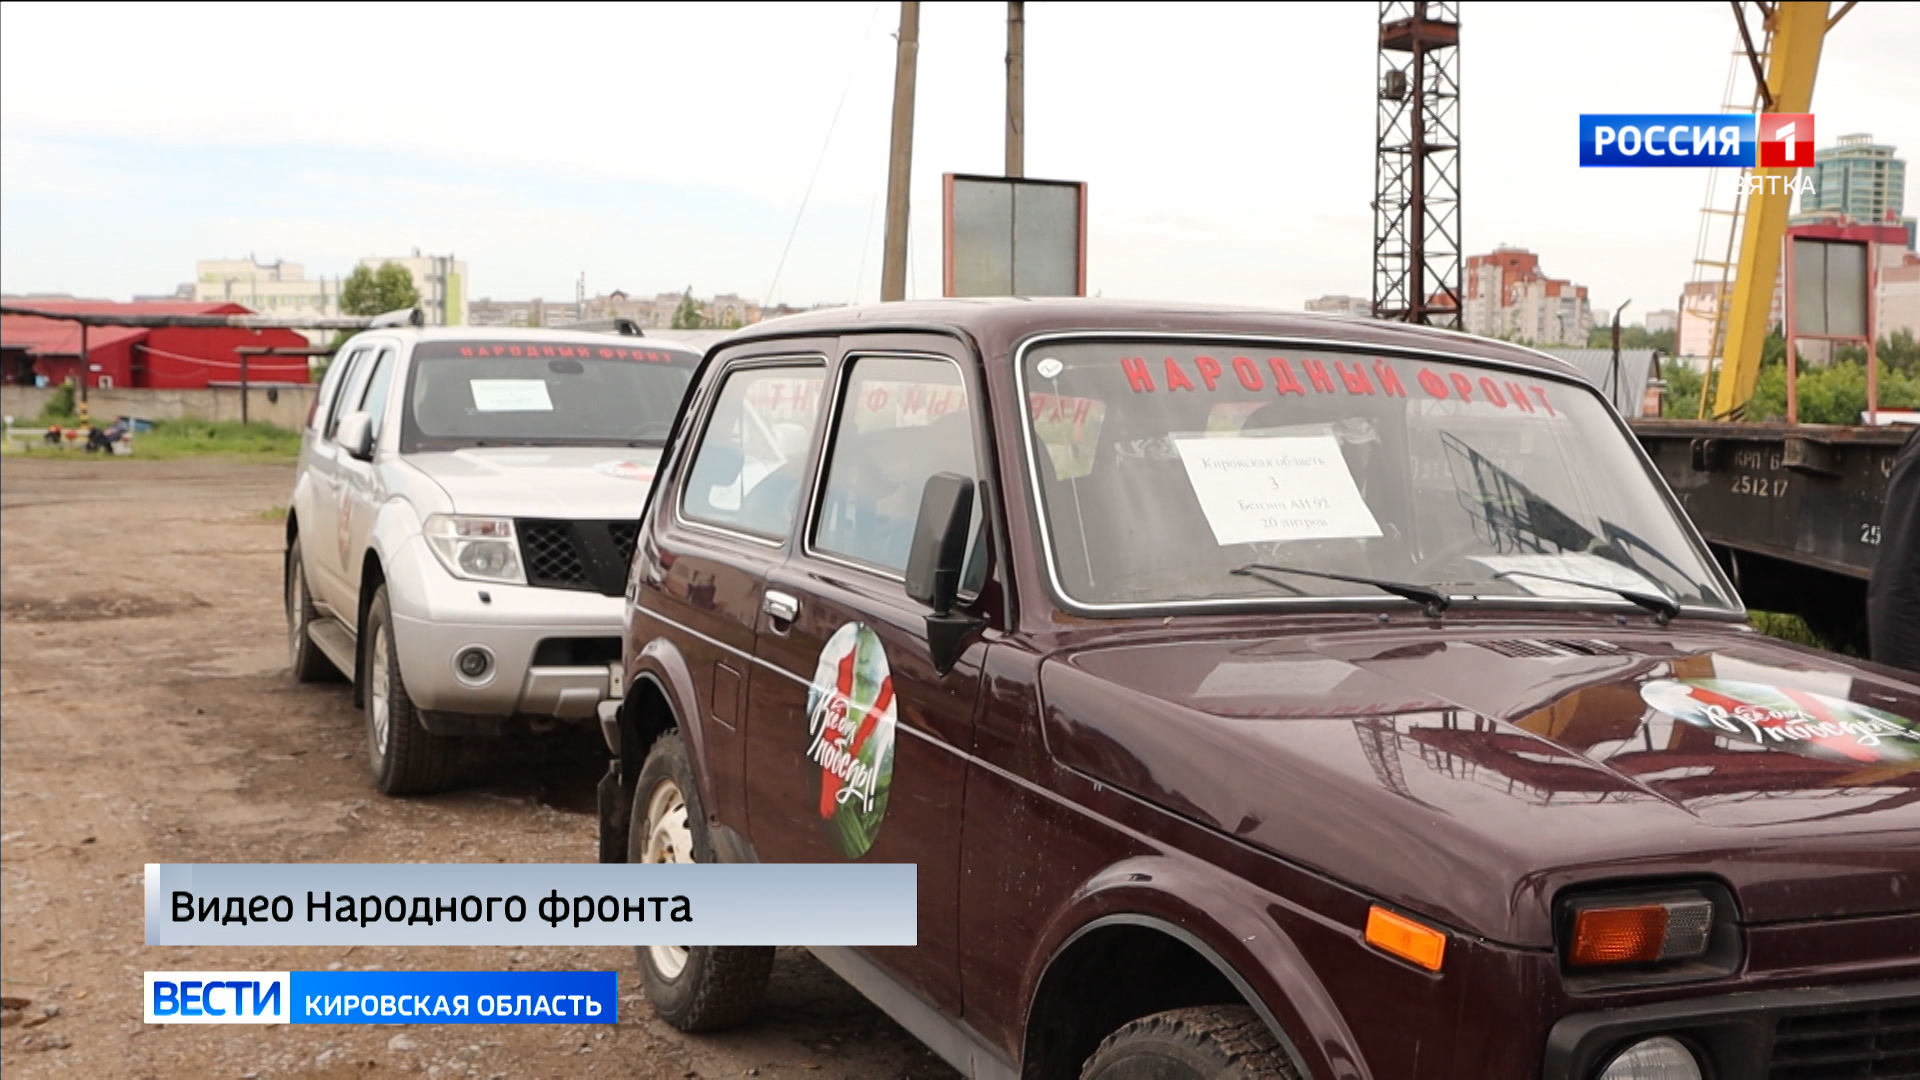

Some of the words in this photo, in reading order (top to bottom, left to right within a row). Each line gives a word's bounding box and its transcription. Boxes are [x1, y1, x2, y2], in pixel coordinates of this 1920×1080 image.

[460, 345, 591, 358] НАРОДНЫЙ
[599, 349, 673, 363] ФРОНТ
[1120, 355, 1407, 399] НАРОДНЫЙ
[1415, 366, 1556, 418] ФРОНТ
[1201, 456, 1272, 471] Кировская
[1276, 455, 1326, 468] область
[1268, 476, 1280, 490] 3
[1313, 498, 1331, 510] 92
[1260, 517, 1279, 530] 20
